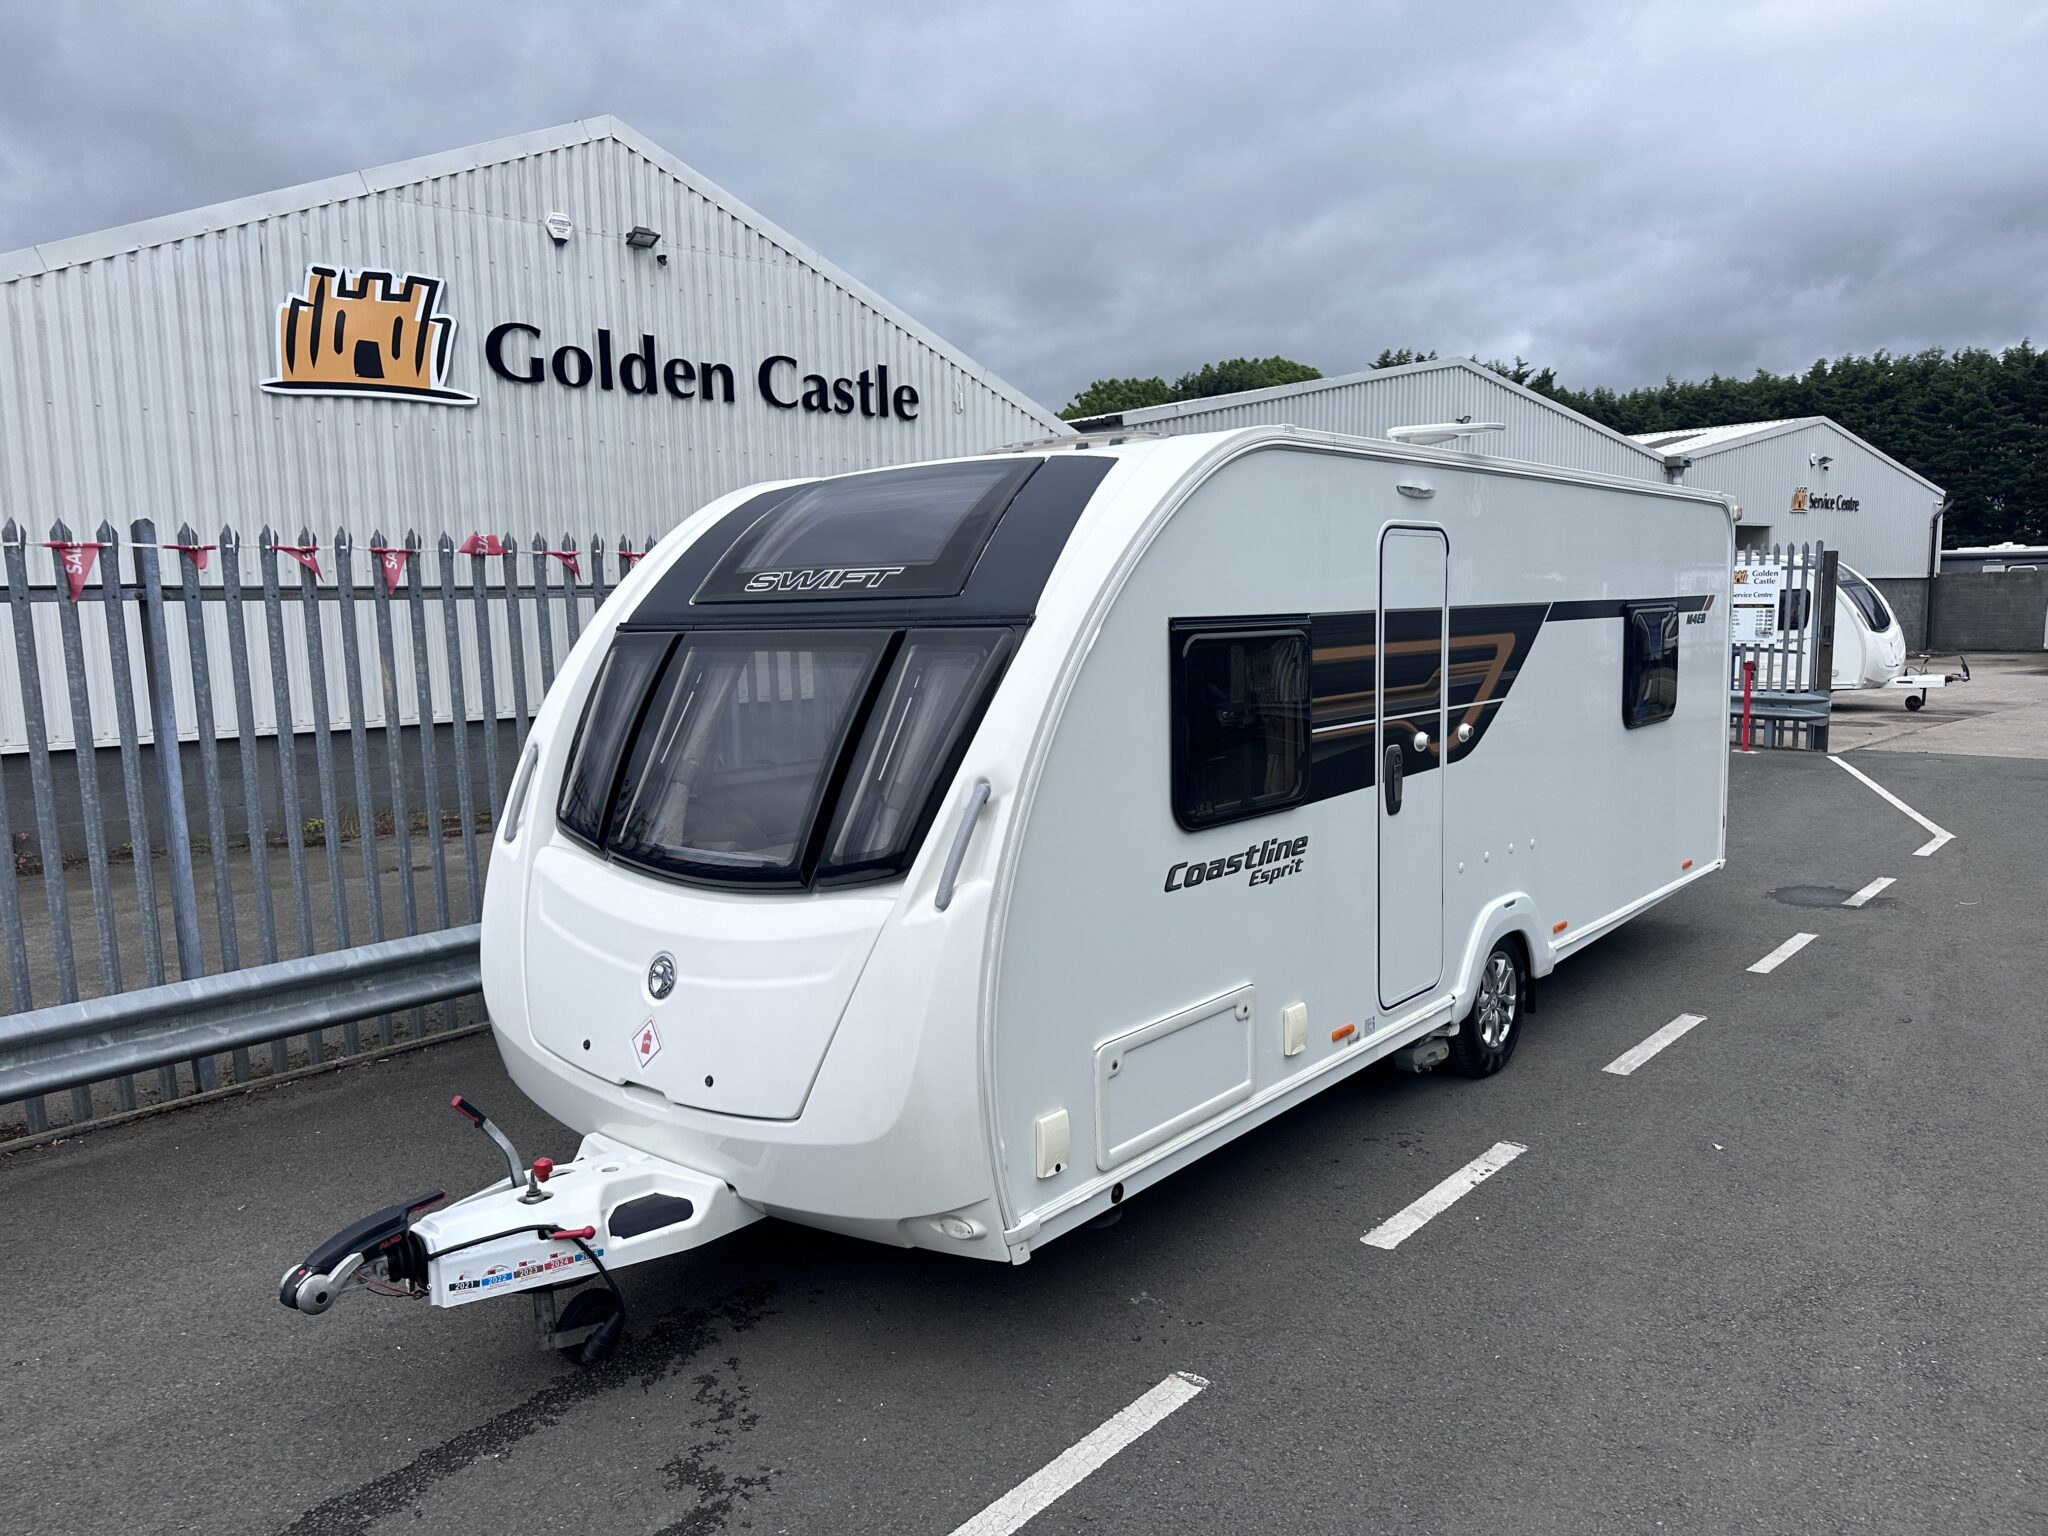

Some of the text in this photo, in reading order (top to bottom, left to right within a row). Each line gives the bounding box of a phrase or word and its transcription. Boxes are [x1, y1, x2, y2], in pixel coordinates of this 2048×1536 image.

[485, 322, 920, 421] Golden Castle
[1809, 492, 1860, 512] Service Centre
[1752, 569, 1779, 577] Golden
[744, 566, 906, 592] SWIFT
[1753, 577, 1776, 585] Castle
[1753, 591, 1774, 599] Centre
[1164, 835, 1309, 893] Coastline
[1248, 858, 1304, 887] Esprit
[550, 1257, 569, 1269] 2024
[519, 1266, 538, 1277] 2023
[455, 1280, 474, 1290] 2021
[488, 1274, 507, 1285] 2022
